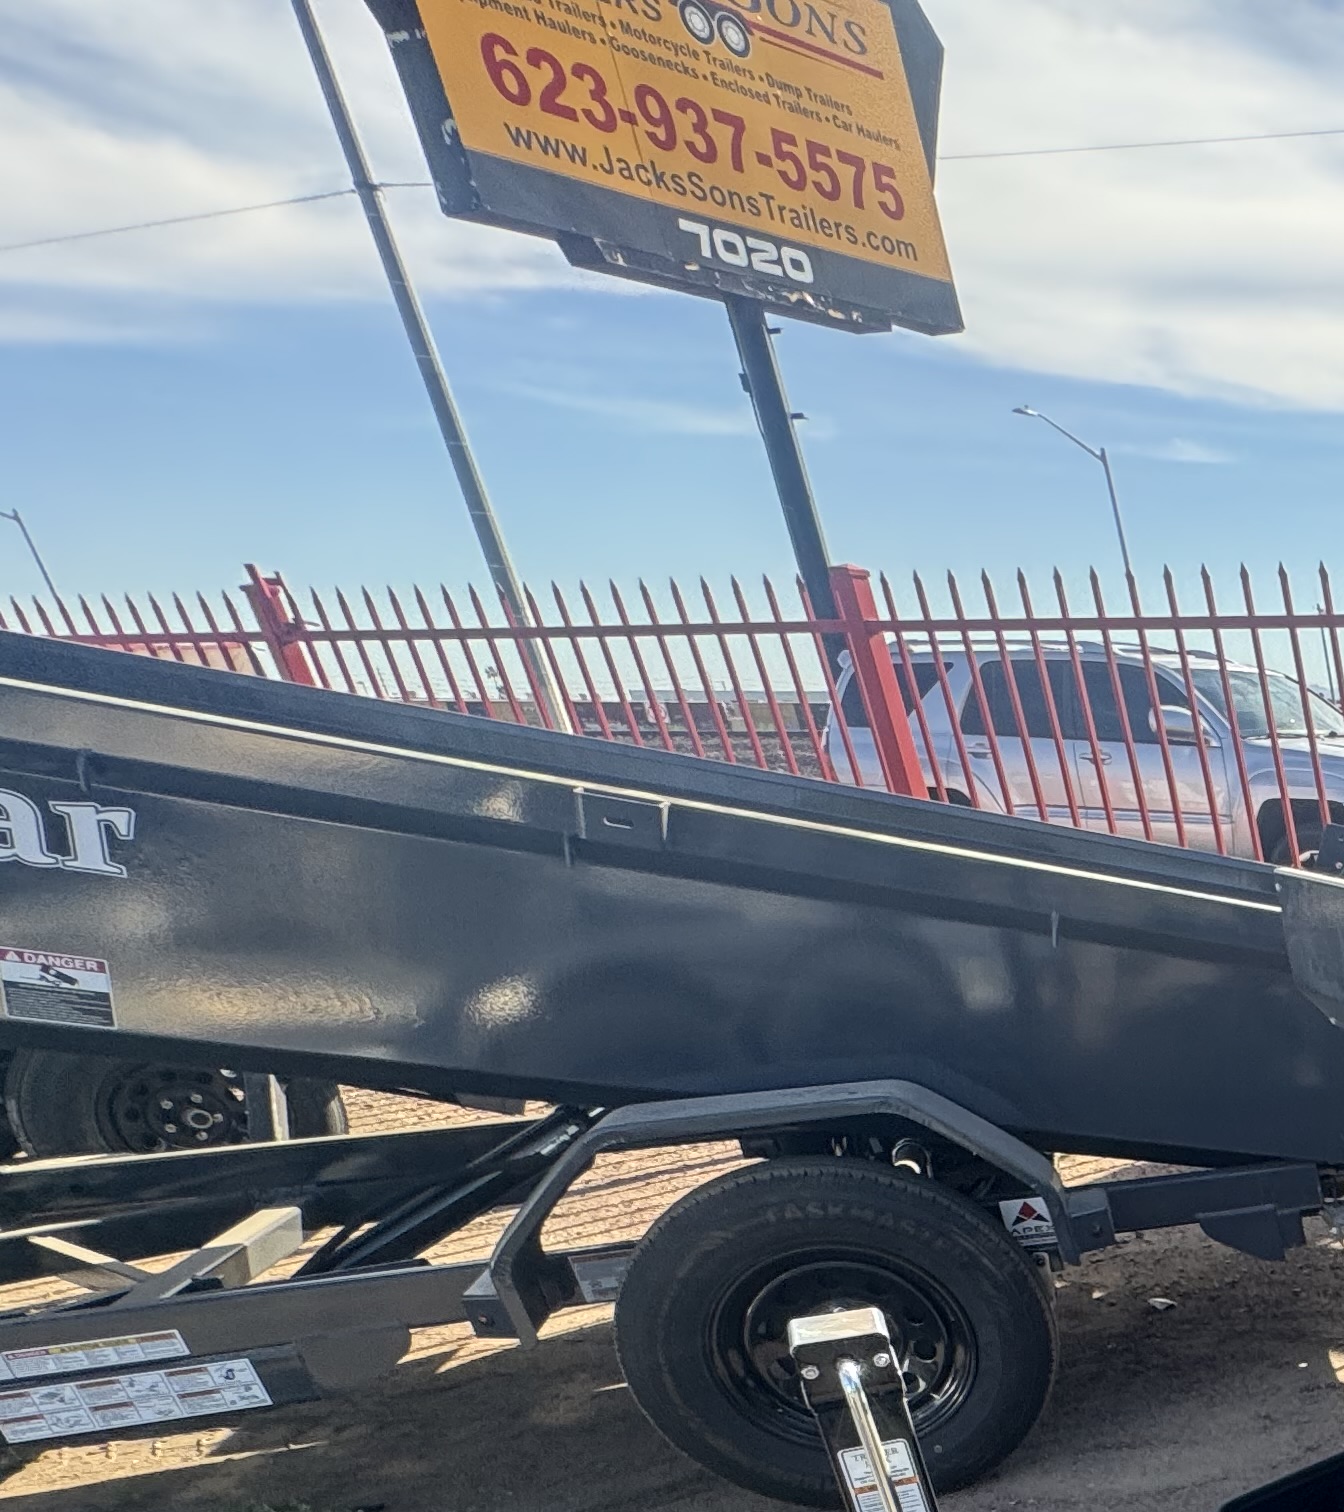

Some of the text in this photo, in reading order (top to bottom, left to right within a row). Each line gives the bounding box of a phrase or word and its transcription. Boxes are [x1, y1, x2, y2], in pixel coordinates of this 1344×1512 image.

[481, 32, 905, 221] 623-937-5575
[533, 8, 597, 44] Haulers
[609, 36, 699, 80] Goosenecks
[712, 71, 770, 106] Enclosed
[772, 92, 822, 123] Trailers
[832, 114, 853, 131] Car
[857, 123, 901, 150] Haulers
[619, 19, 700, 60] Motorcycle
[703, 50, 755, 81] Trailers
[766, 72, 803, 99] Dump
[804, 86, 853, 116] Trailers
[503, 121, 918, 262] www.JacksSonsTrailers.com
[677, 217, 814, 284] 7020
[23, 952, 99, 971] DANGER
